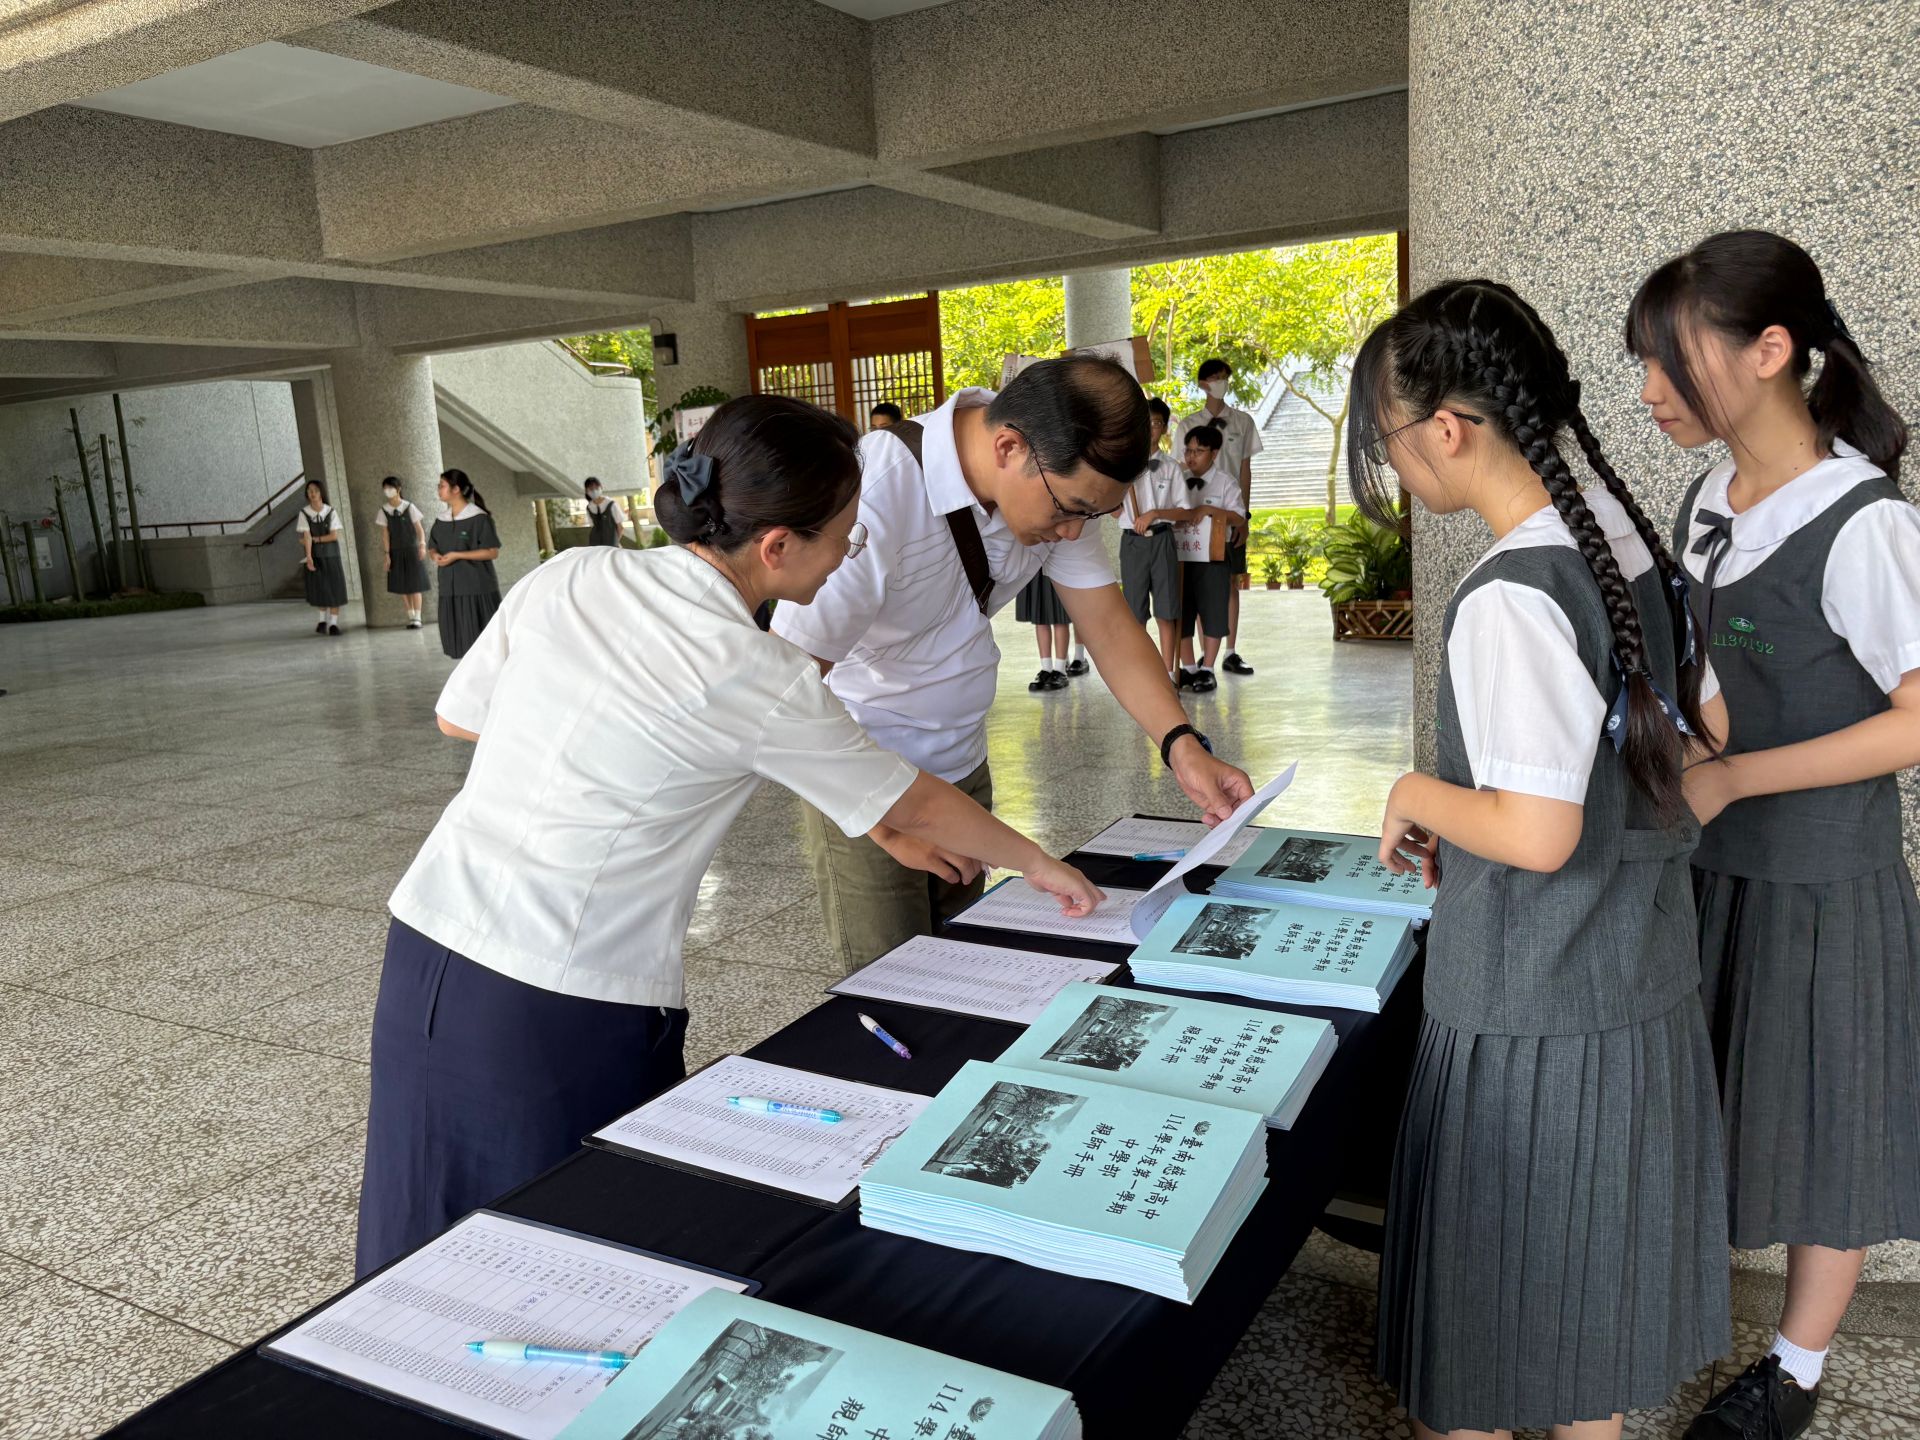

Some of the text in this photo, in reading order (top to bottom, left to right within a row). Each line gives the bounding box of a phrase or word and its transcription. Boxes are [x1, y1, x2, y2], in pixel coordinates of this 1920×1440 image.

[1161, 1025, 1203, 1064] 親師手冊
[1190, 1036, 1225, 1064] 中學部
[1226, 1035, 1280, 1094] 臺南慈濟高中
[1063, 1122, 1116, 1178] 親師手冊
[1098, 1138, 1139, 1178] 中學部
[1137, 1135, 1204, 1220] 臺南慈濟高中
[910, 1383, 963, 1440] 114學
